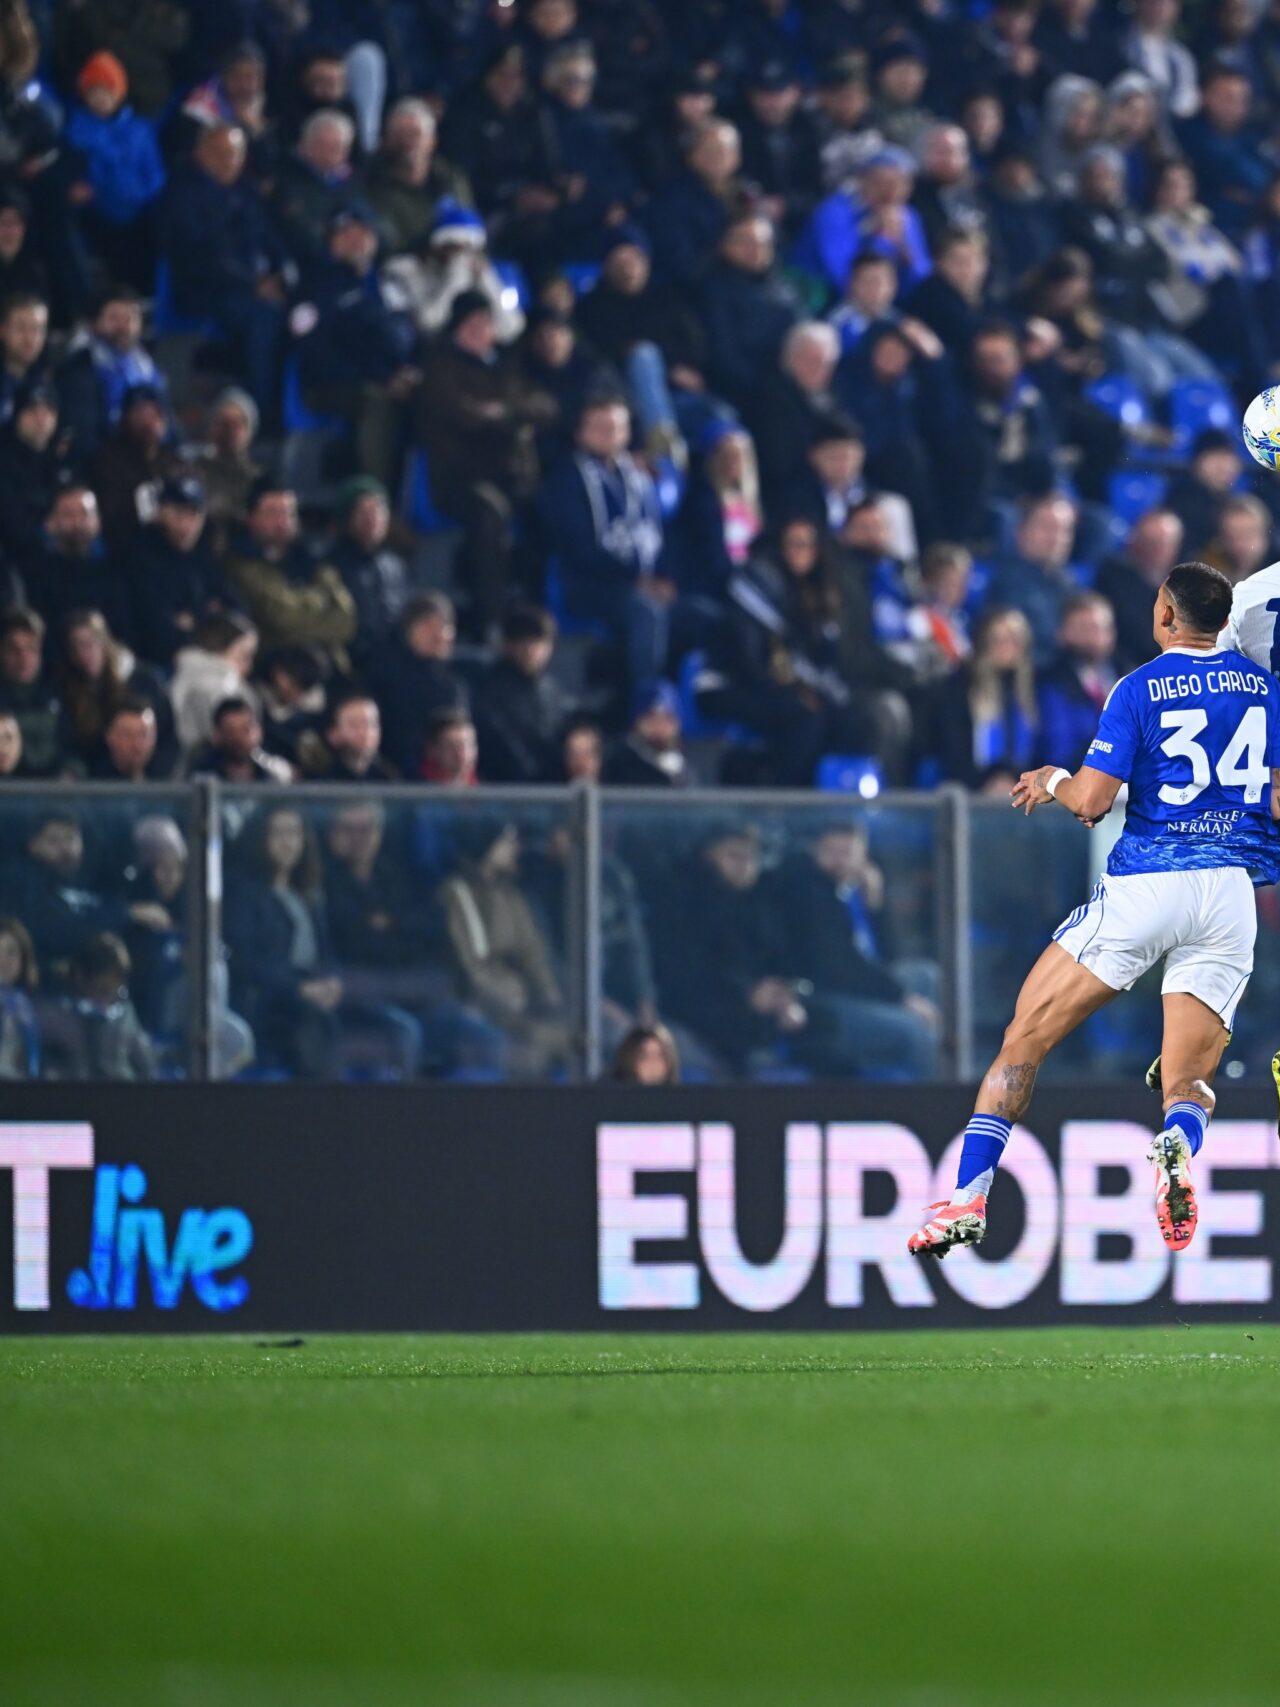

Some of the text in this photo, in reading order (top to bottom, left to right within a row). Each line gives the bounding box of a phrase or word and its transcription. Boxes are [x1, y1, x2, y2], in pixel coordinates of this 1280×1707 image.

[1147, 670, 1268, 702] DIEGO CARLOS
[1157, 706, 1270, 805] 34
